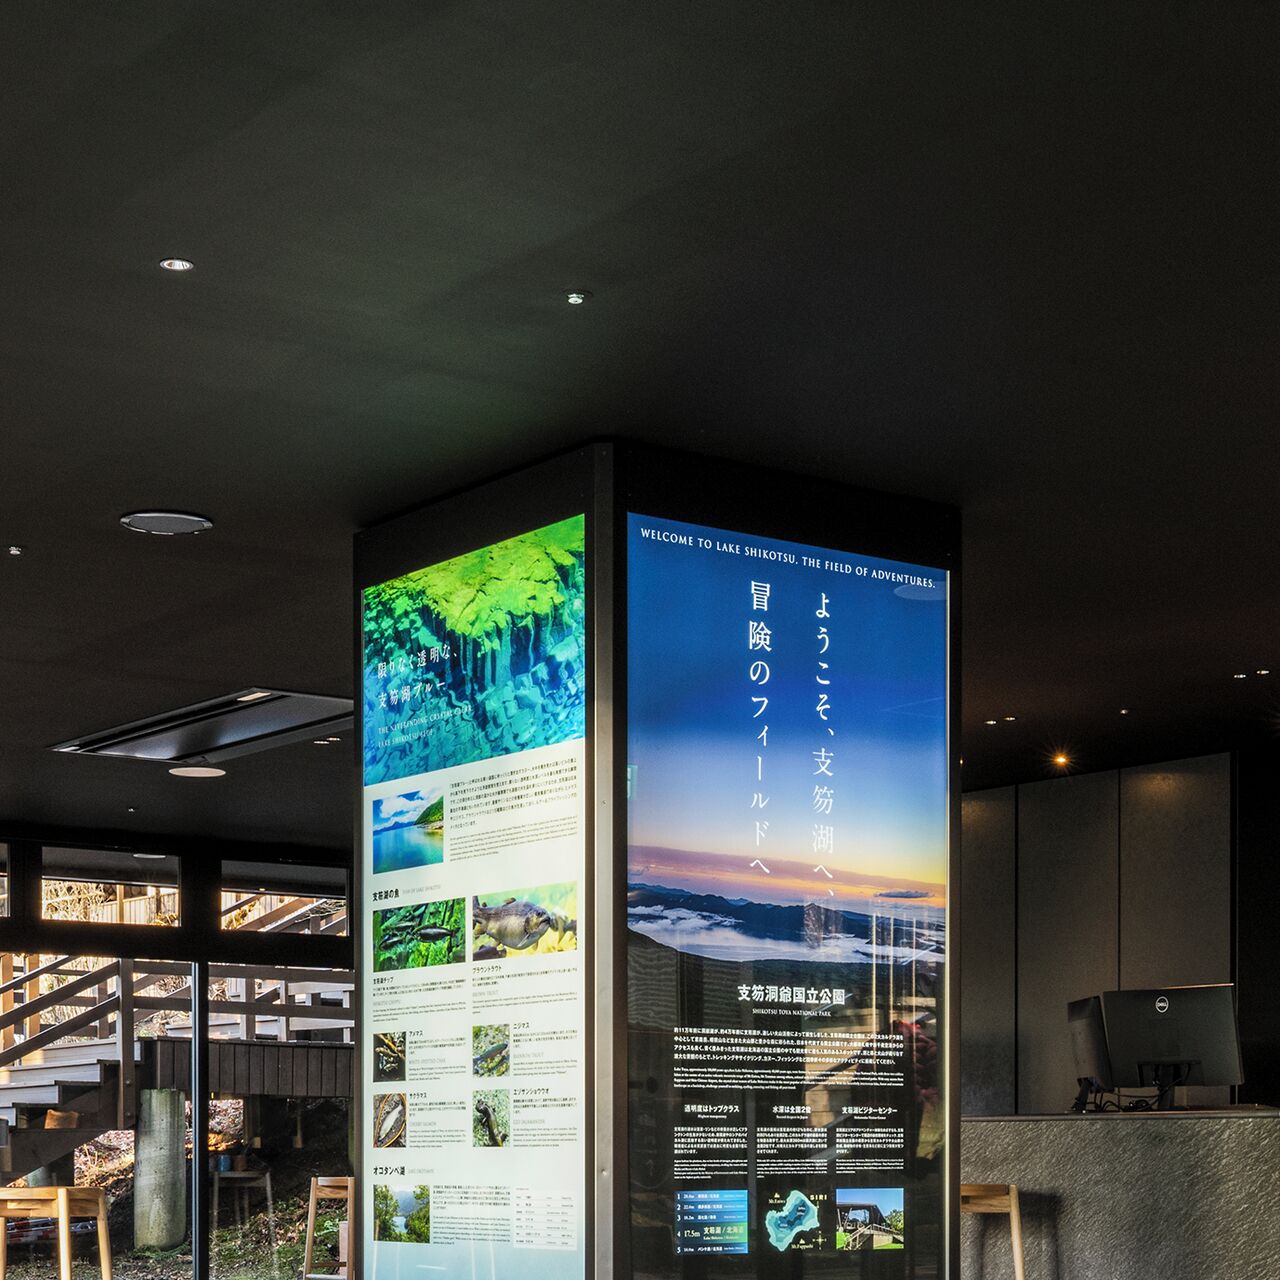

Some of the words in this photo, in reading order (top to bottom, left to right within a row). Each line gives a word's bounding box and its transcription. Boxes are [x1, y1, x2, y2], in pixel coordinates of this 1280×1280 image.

[640, 528, 694, 546] WELCOME
[698, 538, 712, 549] TO
[716, 542, 740, 554] LAKE
[744, 546, 798, 564] SHIKOTSU.
[802, 556, 820, 569] THE
[824, 560, 852, 574] FIELD
[855, 566, 868, 577] OF
[872, 570, 936, 589] ADVENTURES.
[748, 580, 772, 874] 冒険のフィールドへ
[812, 592, 835, 897] ようこそ、支笏湖へ、
[738, 984, 845, 1005] 支笏洞爺国立公園
